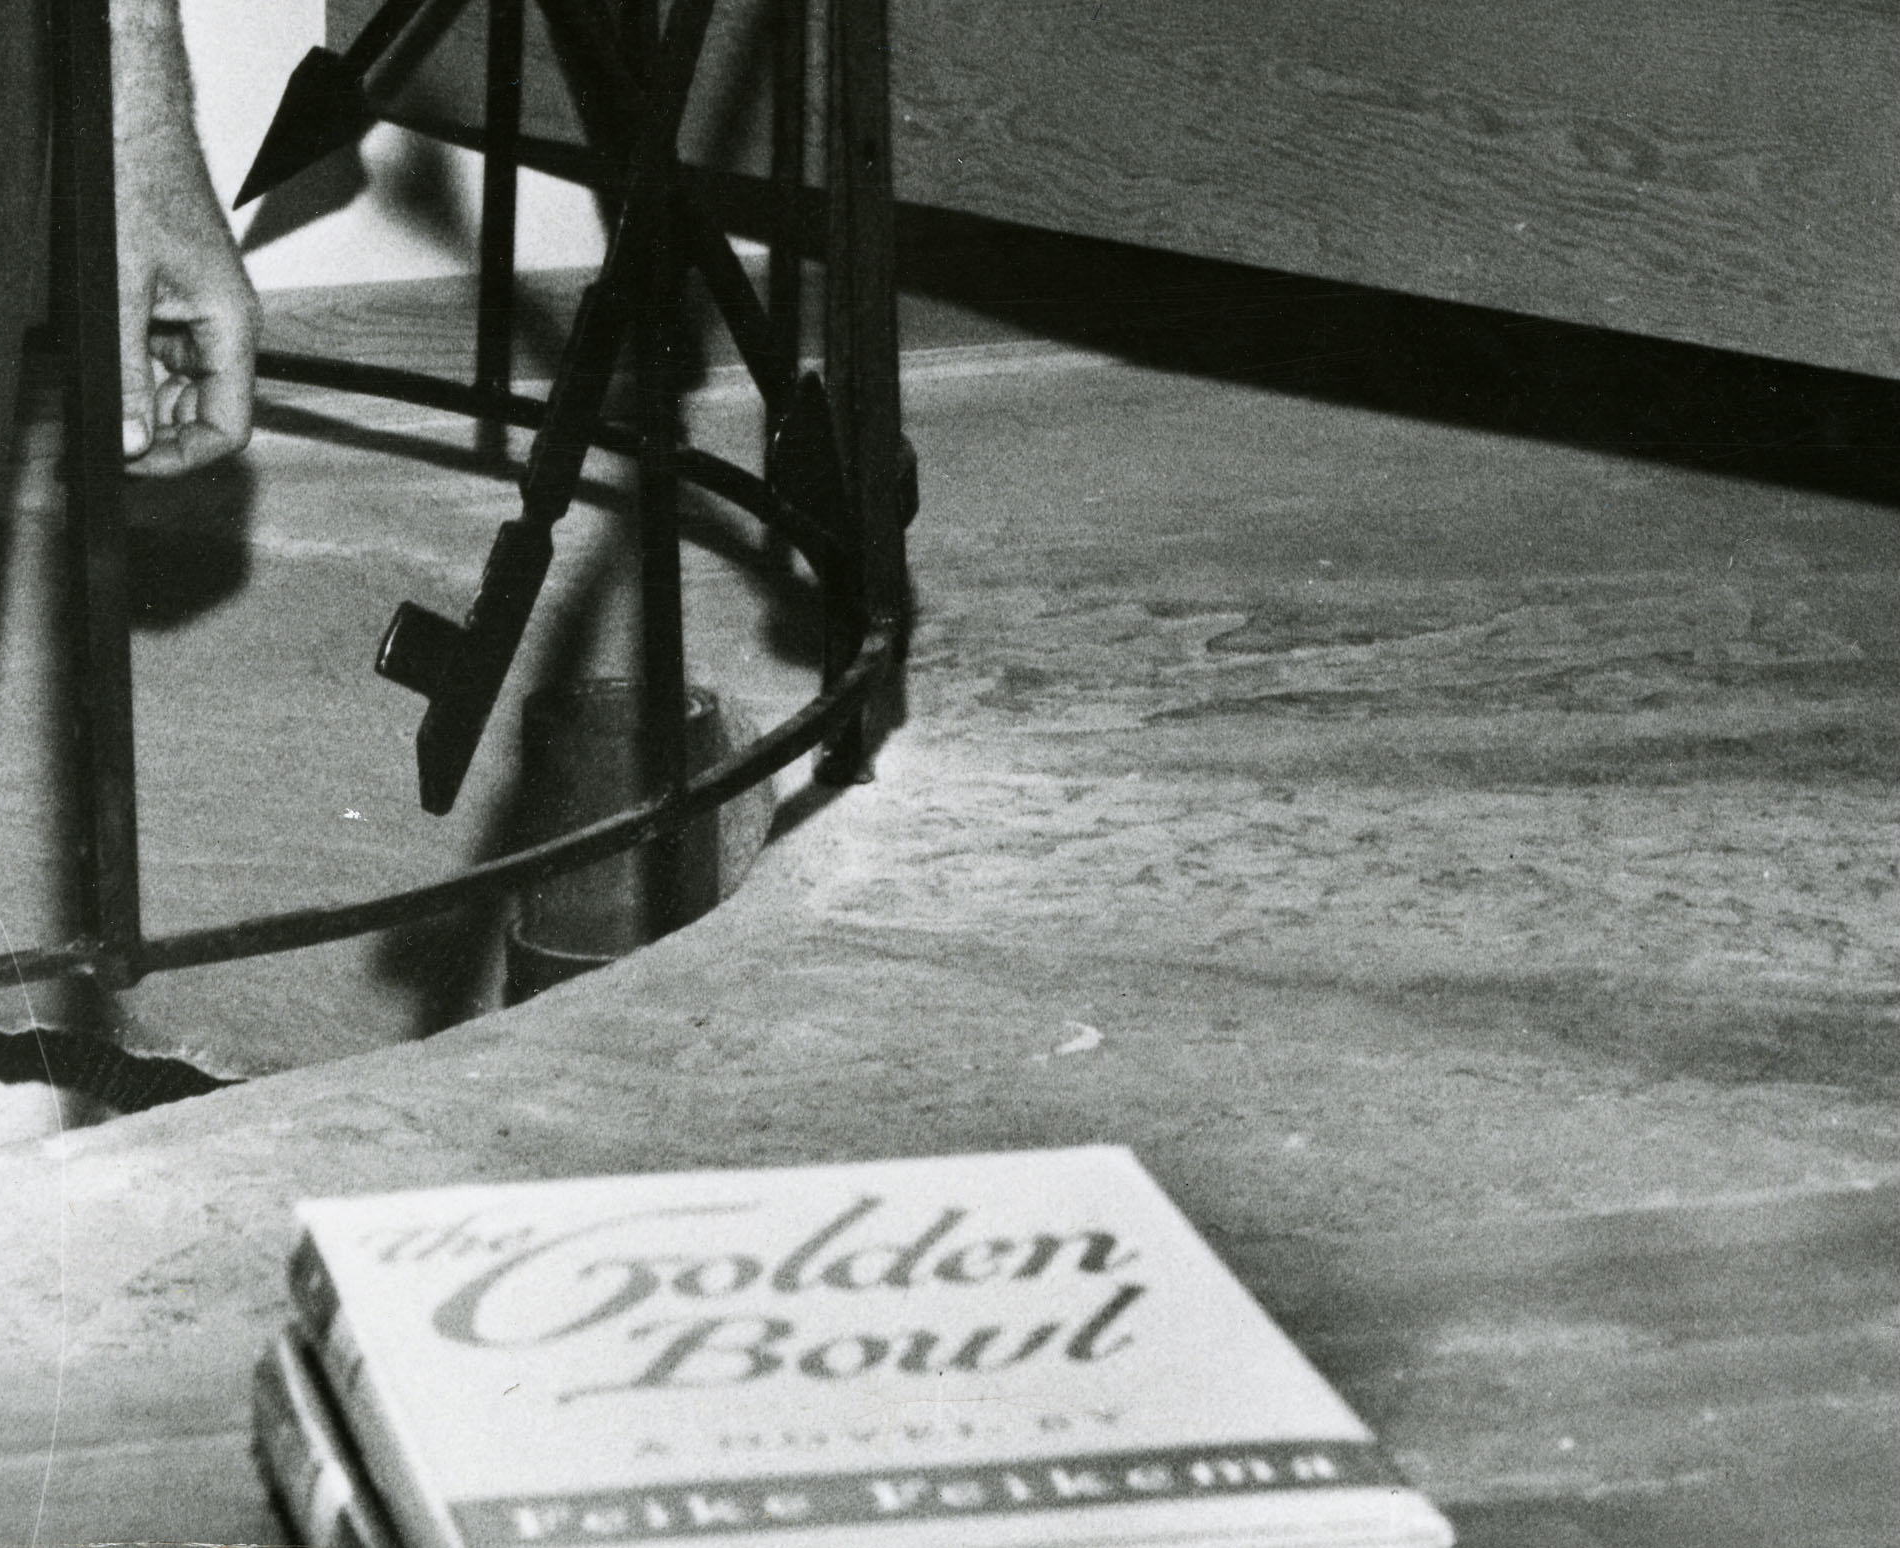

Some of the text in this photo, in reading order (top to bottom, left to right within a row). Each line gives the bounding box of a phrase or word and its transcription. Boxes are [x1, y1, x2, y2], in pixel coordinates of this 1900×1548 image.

[433, 1196, 1139, 1348] Golden
[558, 1284, 1145, 1405] Bowl
[512, 1452, 1338, 1539] Feike Feikema
